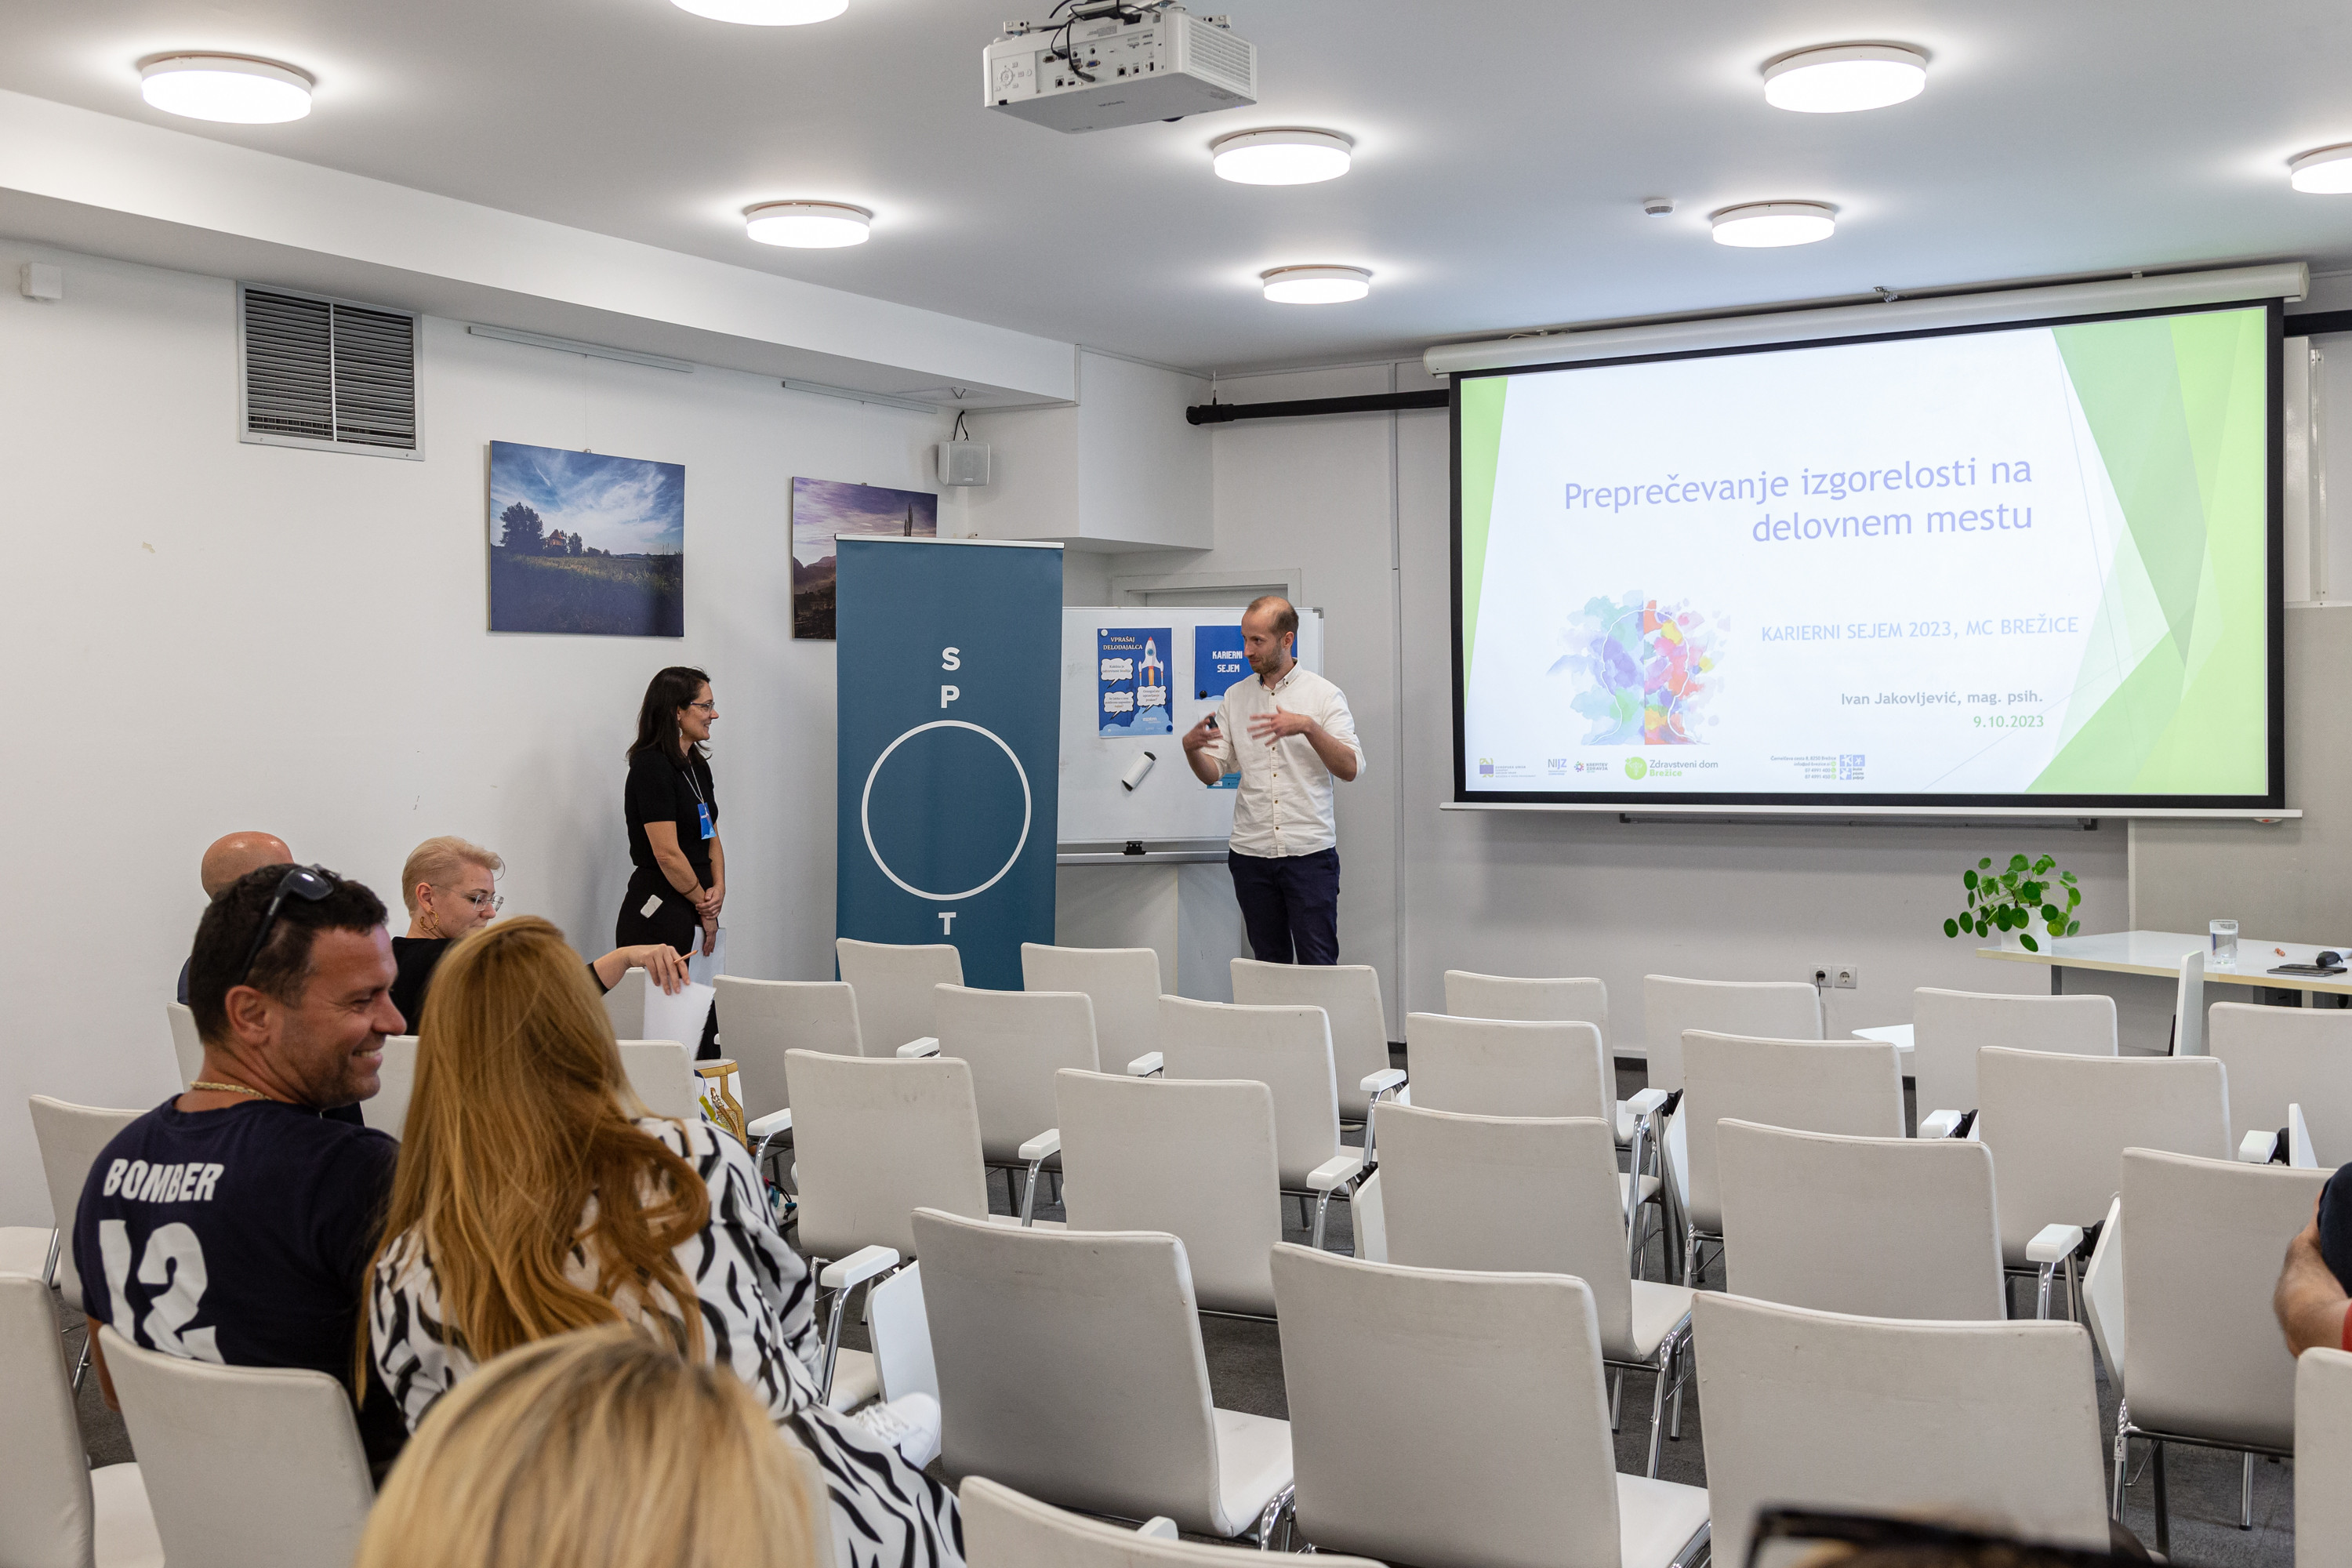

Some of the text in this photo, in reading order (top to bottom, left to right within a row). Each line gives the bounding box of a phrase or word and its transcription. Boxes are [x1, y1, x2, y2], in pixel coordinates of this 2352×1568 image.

[1565, 458, 2032, 514] Preprečevanje izgorelosti na
[1753, 504, 2032, 542] delovnem mestu
[1762, 613, 2079, 641] KARIERNI SEJEM 2023, MC BREŽICE
[1212, 651, 1243, 659] KARIERNI
[1217, 664, 1240, 673] SEJEM
[1841, 691, 2043, 706] Ivan Jakovljević, mag. psih.
[1973, 715, 2044, 728] 9.10.2023
[1548, 759, 1567, 768] NIJZ
[1650, 760, 1719, 768] Zdravstveni dom
[103, 1158, 224, 1203] BOMBER
[99, 1219, 226, 1365] 12
